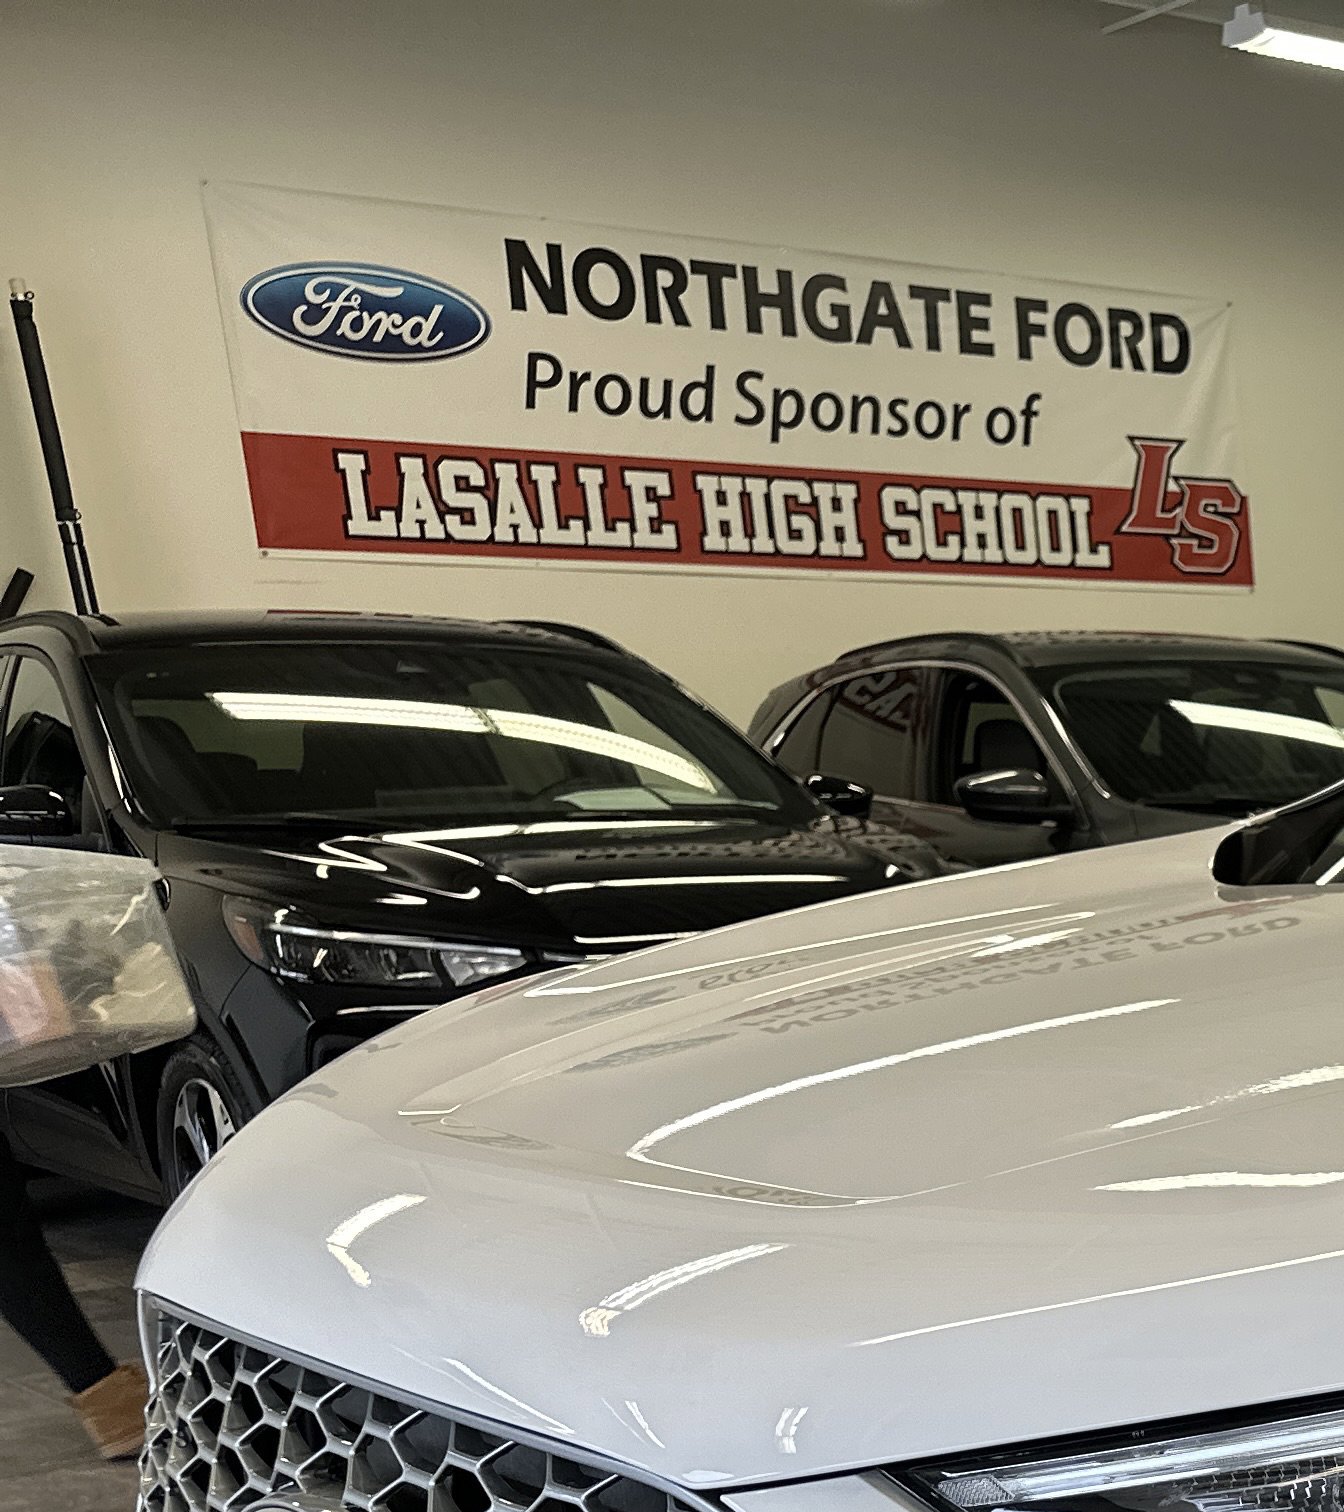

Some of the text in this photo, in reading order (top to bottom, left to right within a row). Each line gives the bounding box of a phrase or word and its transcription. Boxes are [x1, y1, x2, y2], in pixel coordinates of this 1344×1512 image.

[291, 275, 445, 348] Ford
[503, 237, 1191, 375] NORTHGATE FORD
[525, 351, 1042, 447] Proud Sponsor of
[332, 448, 1112, 570] LASALLE HIGH SCHOOL
[1119, 434, 1245, 575] LS
